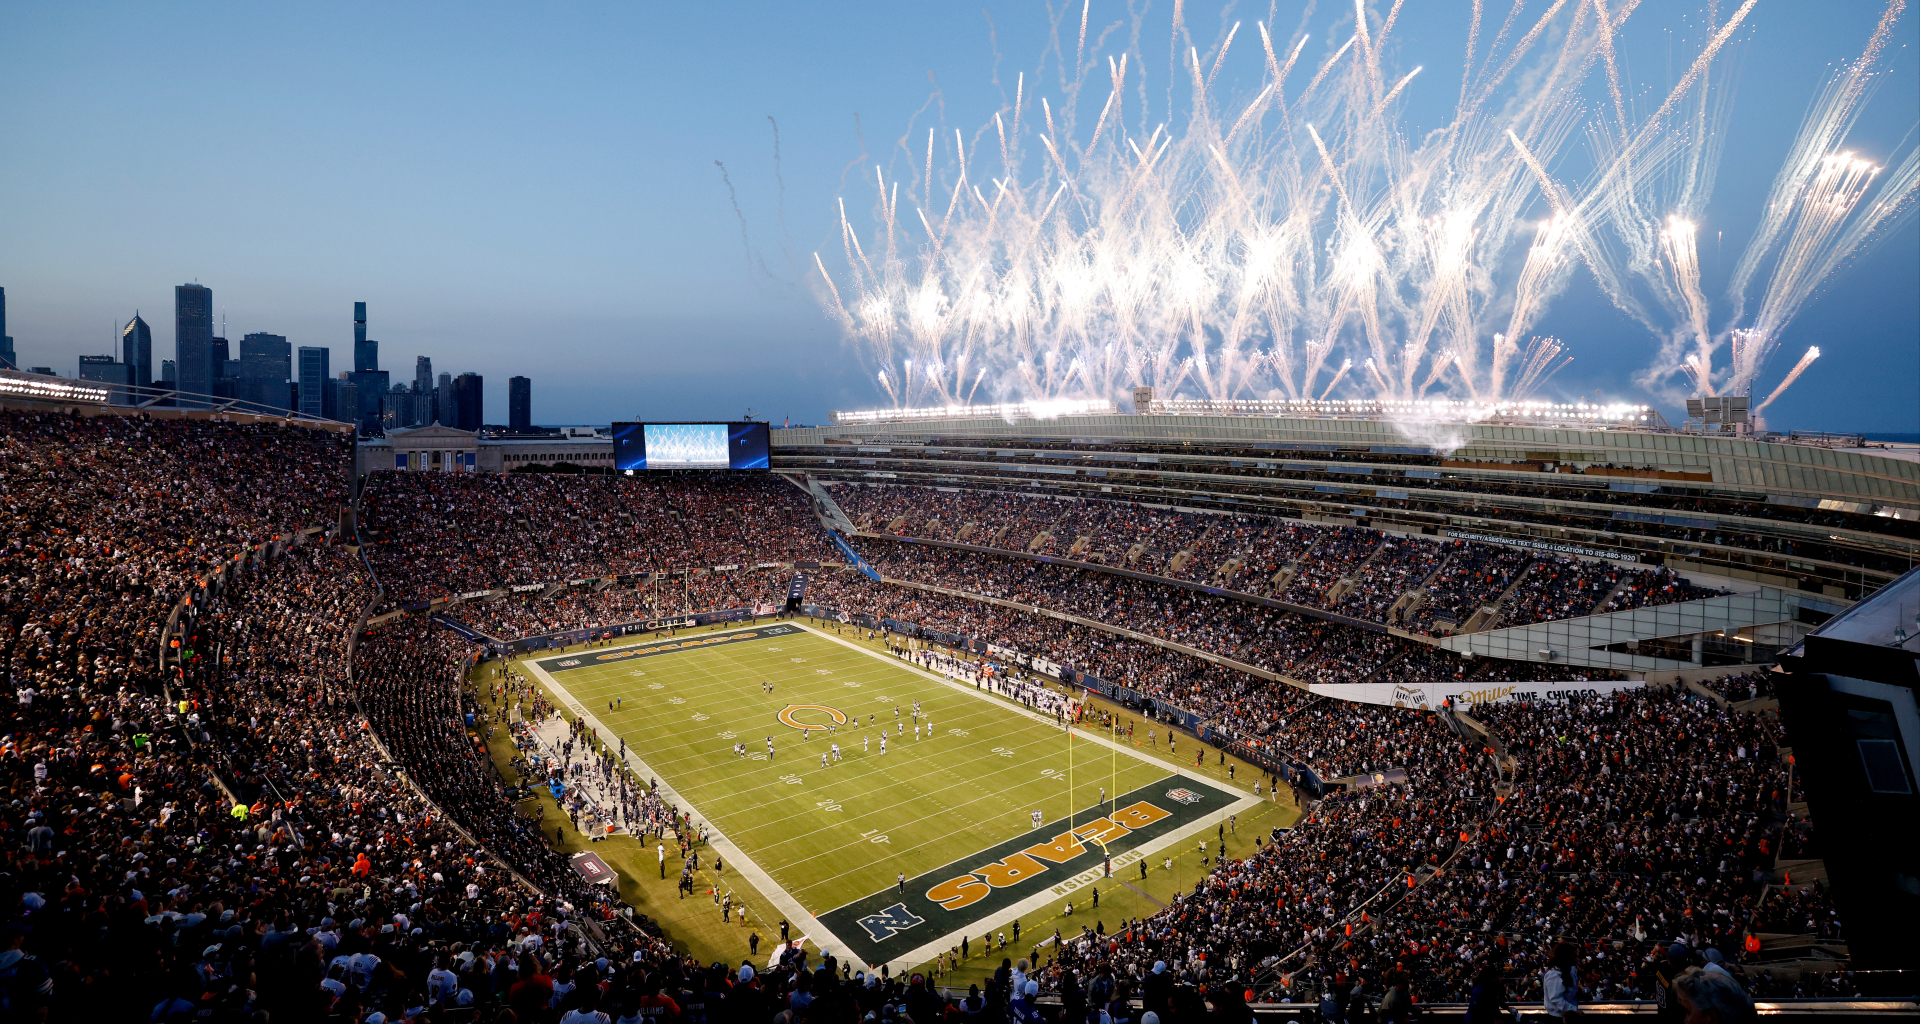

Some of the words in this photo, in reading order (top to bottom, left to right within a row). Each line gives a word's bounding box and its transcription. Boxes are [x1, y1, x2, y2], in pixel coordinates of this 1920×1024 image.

[1554, 545, 1584, 555] LOCATION
[513, 583, 545, 592] DOWN
[895, 620, 949, 644] CHIAGO
[1396, 691, 1410, 700] Lite
[1412, 694, 1426, 704] Lite
[1461, 685, 1516, 709] Miller
[1041, 769, 1066, 780] 10
[816, 798, 842, 812] 20
[860, 829, 889, 844] 10
[926, 800, 1173, 911] BEARS
[1113, 849, 1145, 866] END
[640, 1006, 664, 1015] ILLIAMS
